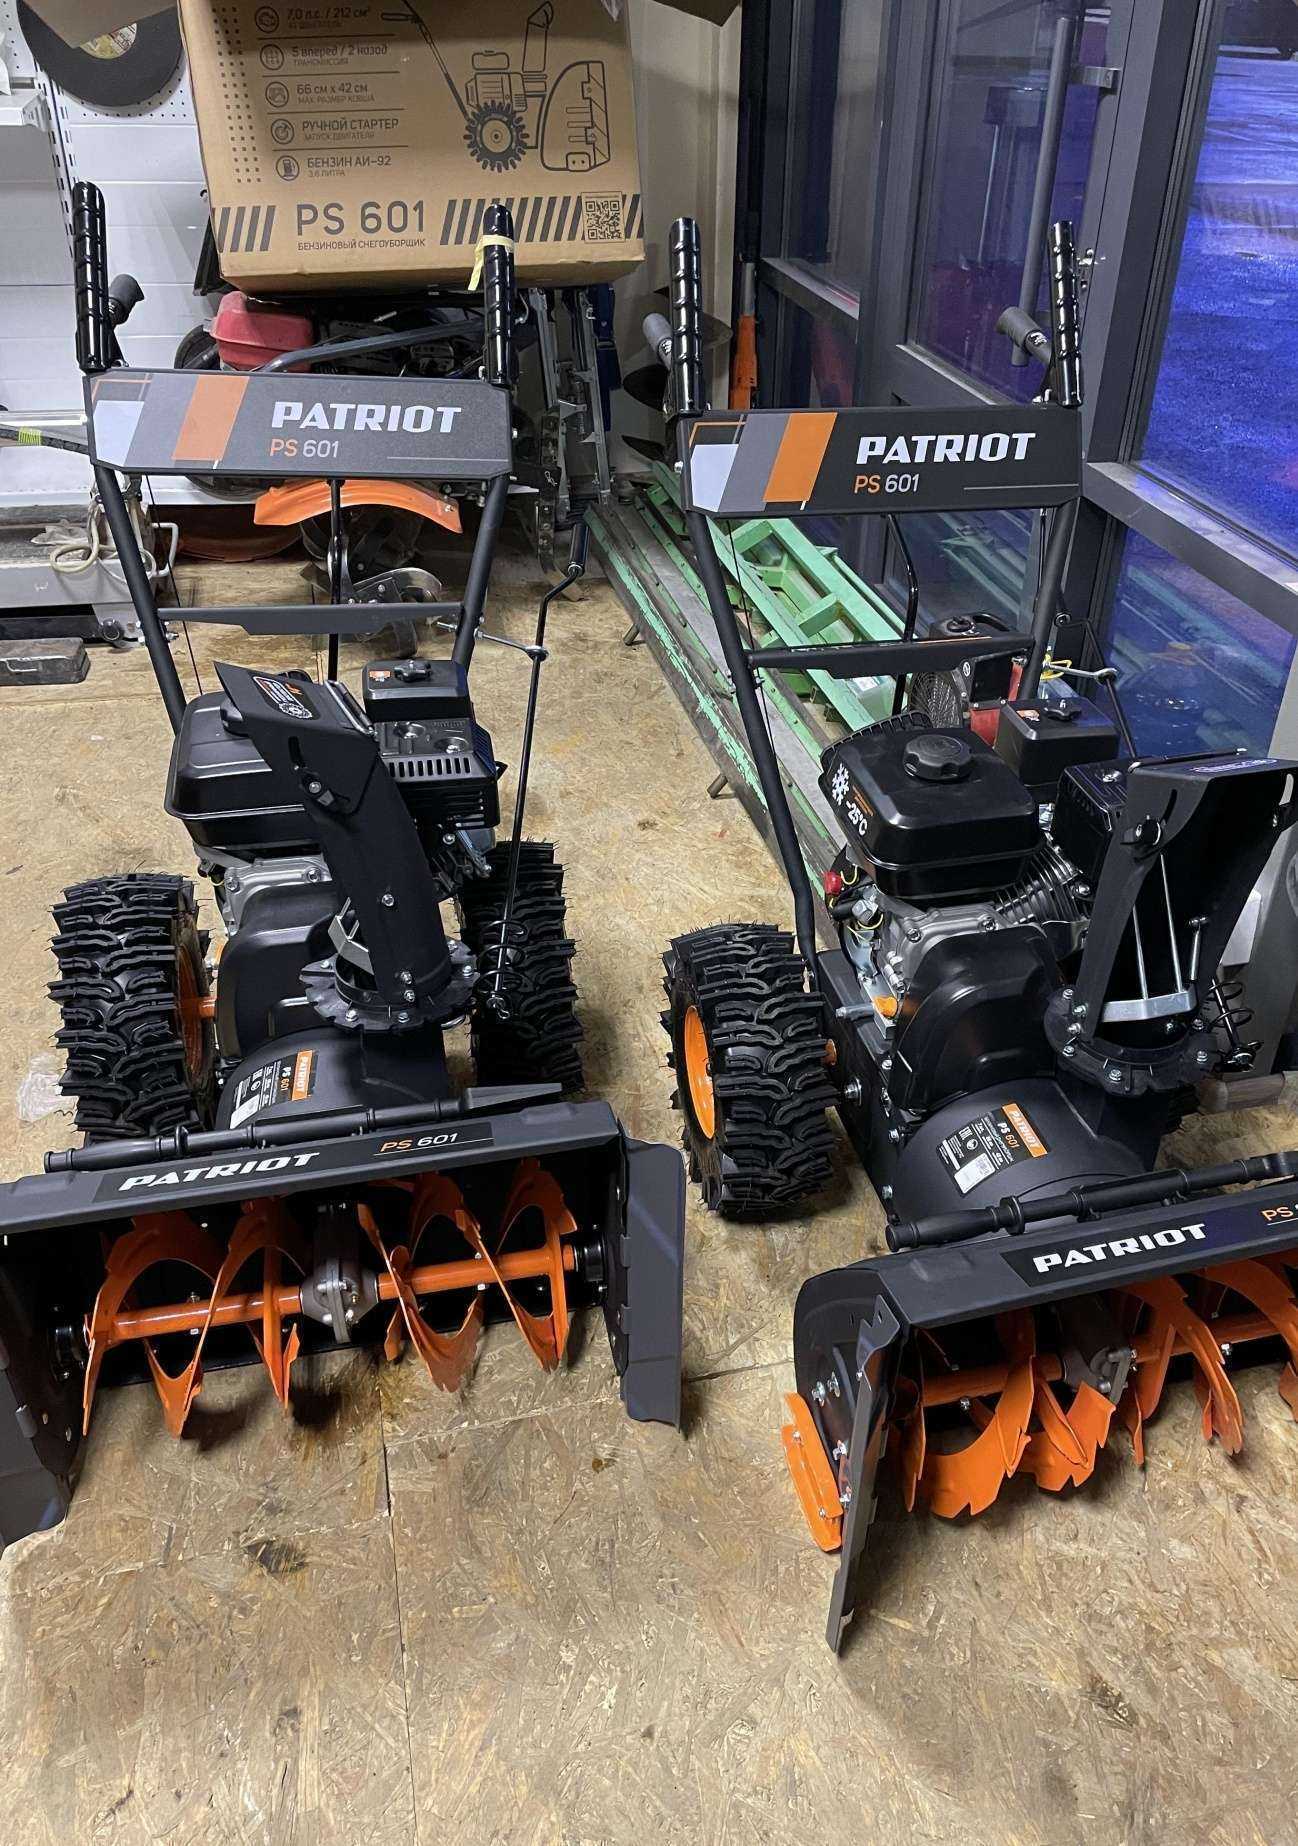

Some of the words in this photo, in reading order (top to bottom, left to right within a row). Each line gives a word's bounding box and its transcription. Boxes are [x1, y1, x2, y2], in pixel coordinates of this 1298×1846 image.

[333, 7, 351, 18] 212
[292, 46, 299, 57] 5
[348, 45, 355, 56] 2
[297, 84, 312, 95] 66
[338, 82, 352, 93] 42
[302, 116, 347, 131] РУЧНОЙ
[350, 118, 399, 130] СТАРТЕР
[307, 157, 352, 168] БЕНЗИН
[296, 202, 345, 236] PS
[360, 200, 424, 234] 601
[298, 239, 357, 251] БЕНЗИНОВЫЙ
[358, 238, 426, 249] СНЕГОУБОРЩИК
[271, 401, 462, 433] PATRIOT
[269, 438, 298, 457] PS
[302, 439, 339, 458] 601
[856, 433, 1036, 465] PATRIOT
[854, 475, 881, 494] PS
[884, 473, 919, 493] 601
[380, 1139, 413, 1152] PS
[416, 1132, 459, 1148] 601
[997, 1122, 1011, 1135] PS
[1005, 1134, 1020, 1149] 601
[118, 1152, 320, 1192] PATRIOT
[1261, 1206, 1294, 1221] PS
[1032, 1223, 1208, 1273] PATRIOT
